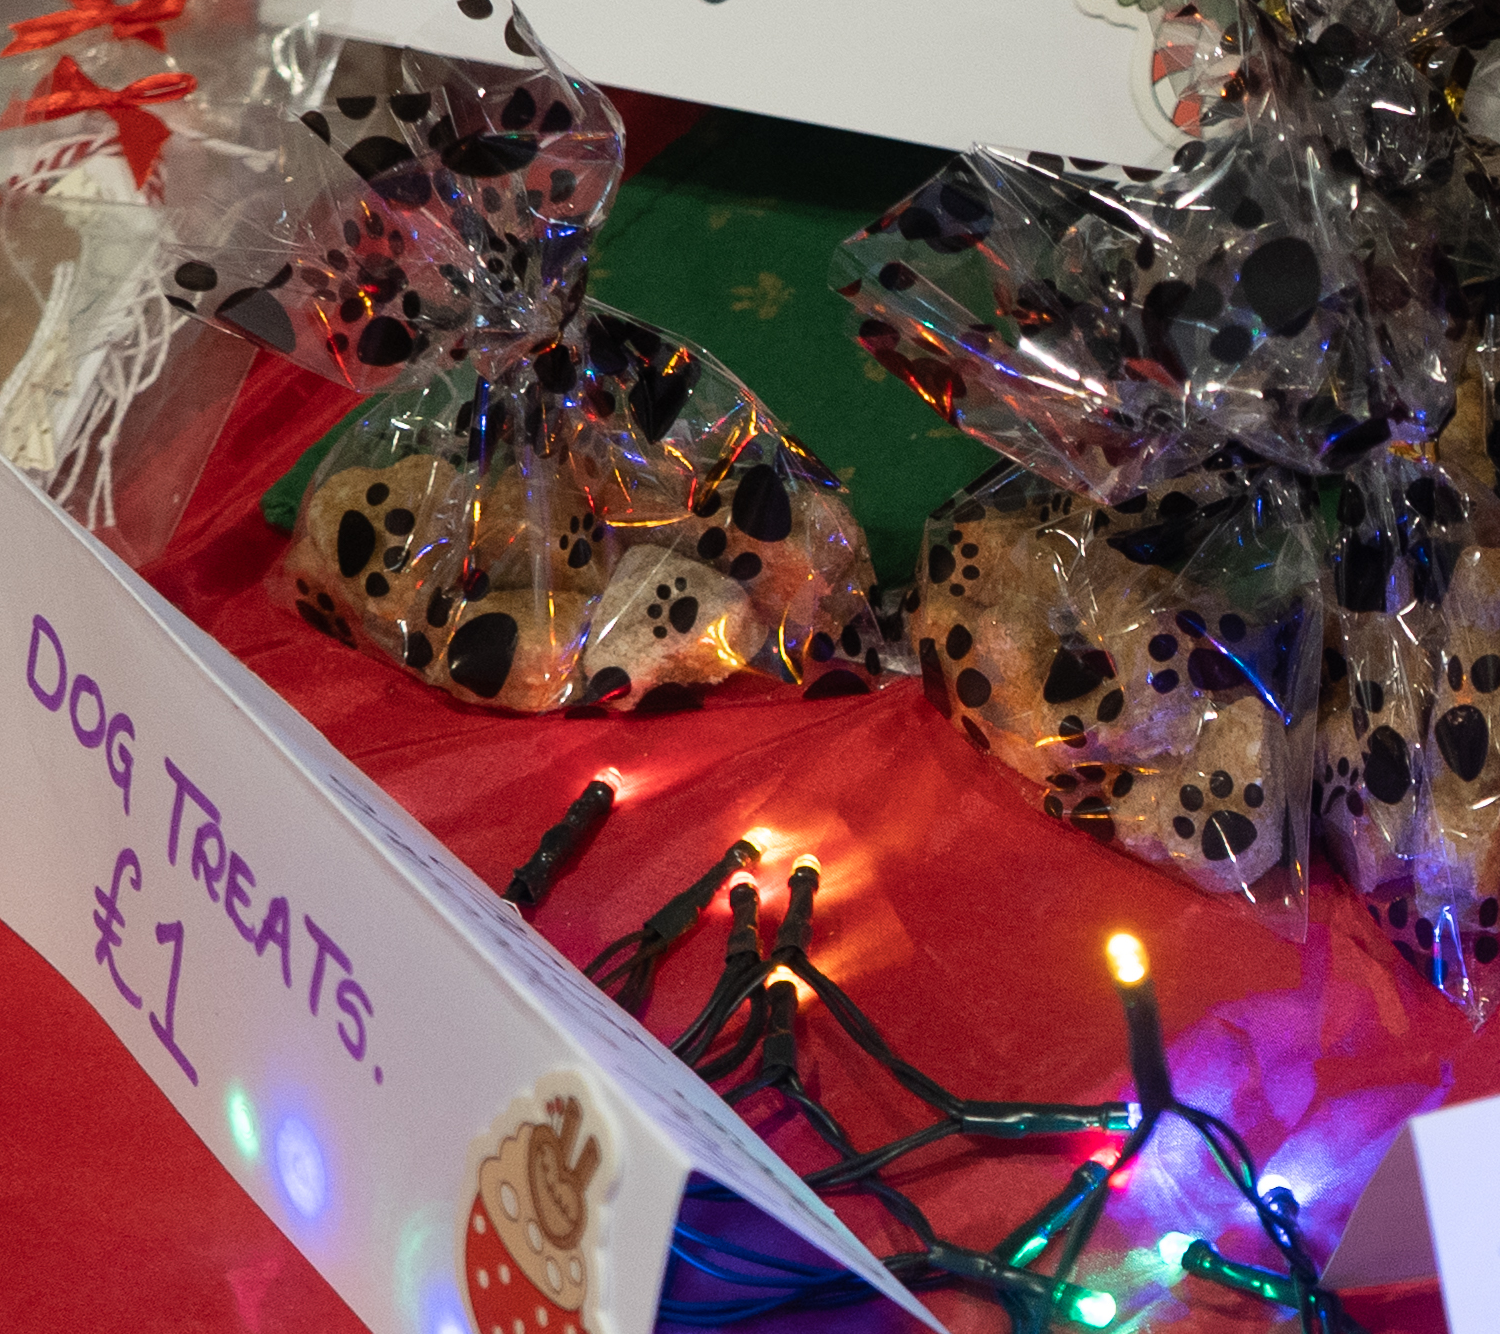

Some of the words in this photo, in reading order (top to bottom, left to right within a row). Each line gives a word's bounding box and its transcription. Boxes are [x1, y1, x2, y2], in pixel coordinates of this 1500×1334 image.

[25, 612, 139, 817] DOG
[162, 754, 386, 1087] TREATS.
[92, 845, 199, 1088] £1
